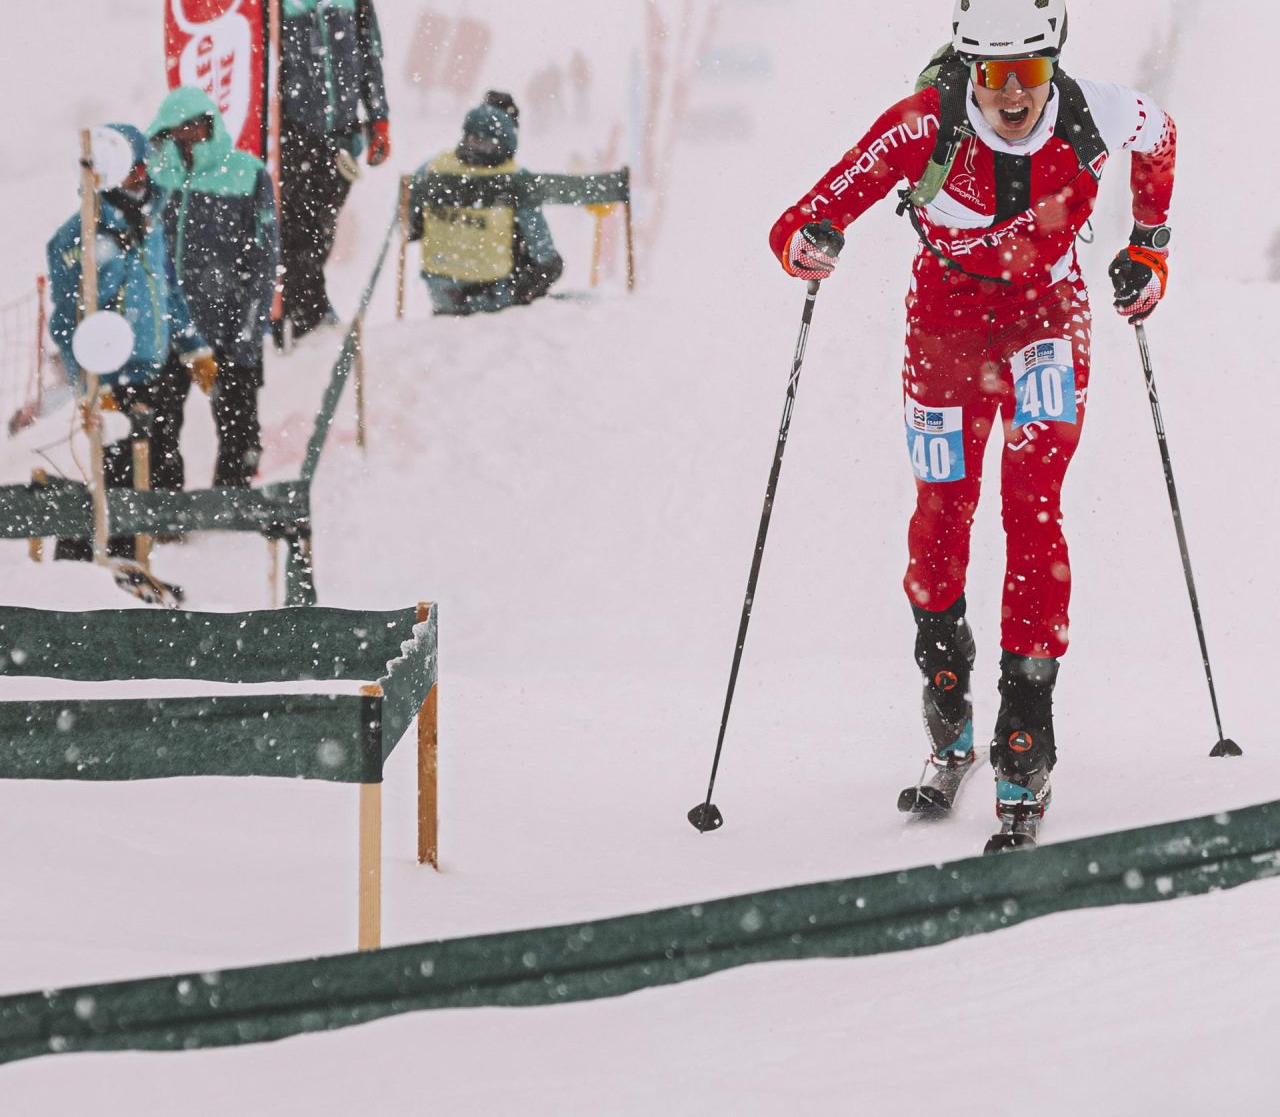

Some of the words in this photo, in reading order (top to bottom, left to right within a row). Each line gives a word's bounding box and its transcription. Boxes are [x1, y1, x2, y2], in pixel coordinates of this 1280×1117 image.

[828, 113, 940, 197] SPORTIVA
[1022, 367, 1064, 418] 40
[911, 434, 951, 480] 40
